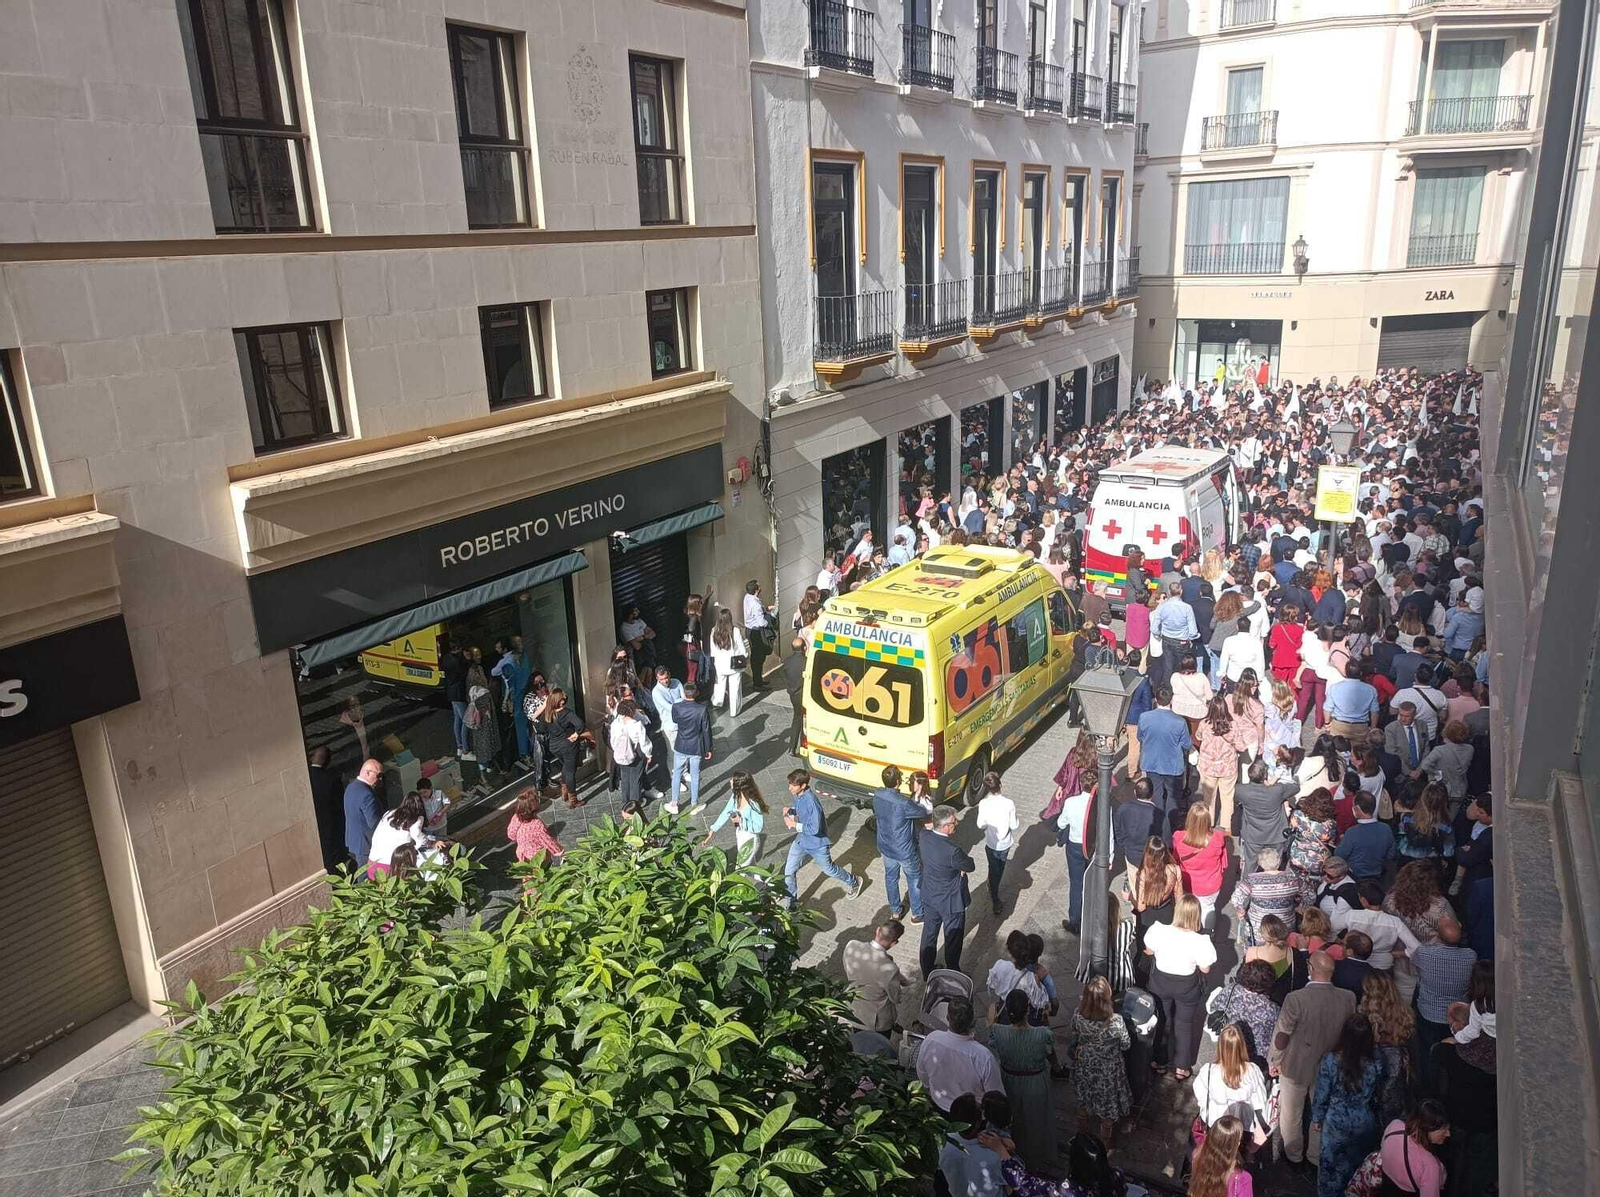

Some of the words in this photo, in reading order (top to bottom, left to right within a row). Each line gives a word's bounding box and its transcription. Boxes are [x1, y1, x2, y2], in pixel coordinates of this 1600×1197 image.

[1425, 290, 1455, 301] ZARA
[1104, 497, 1171, 511] AMBULANCIA
[440, 517, 549, 568] ROBERTO
[555, 494, 625, 530] VERINO
[885, 582, 960, 599] E-270
[997, 572, 1038, 603] AMBULANCIA
[824, 620, 913, 647] AMBULANCIA
